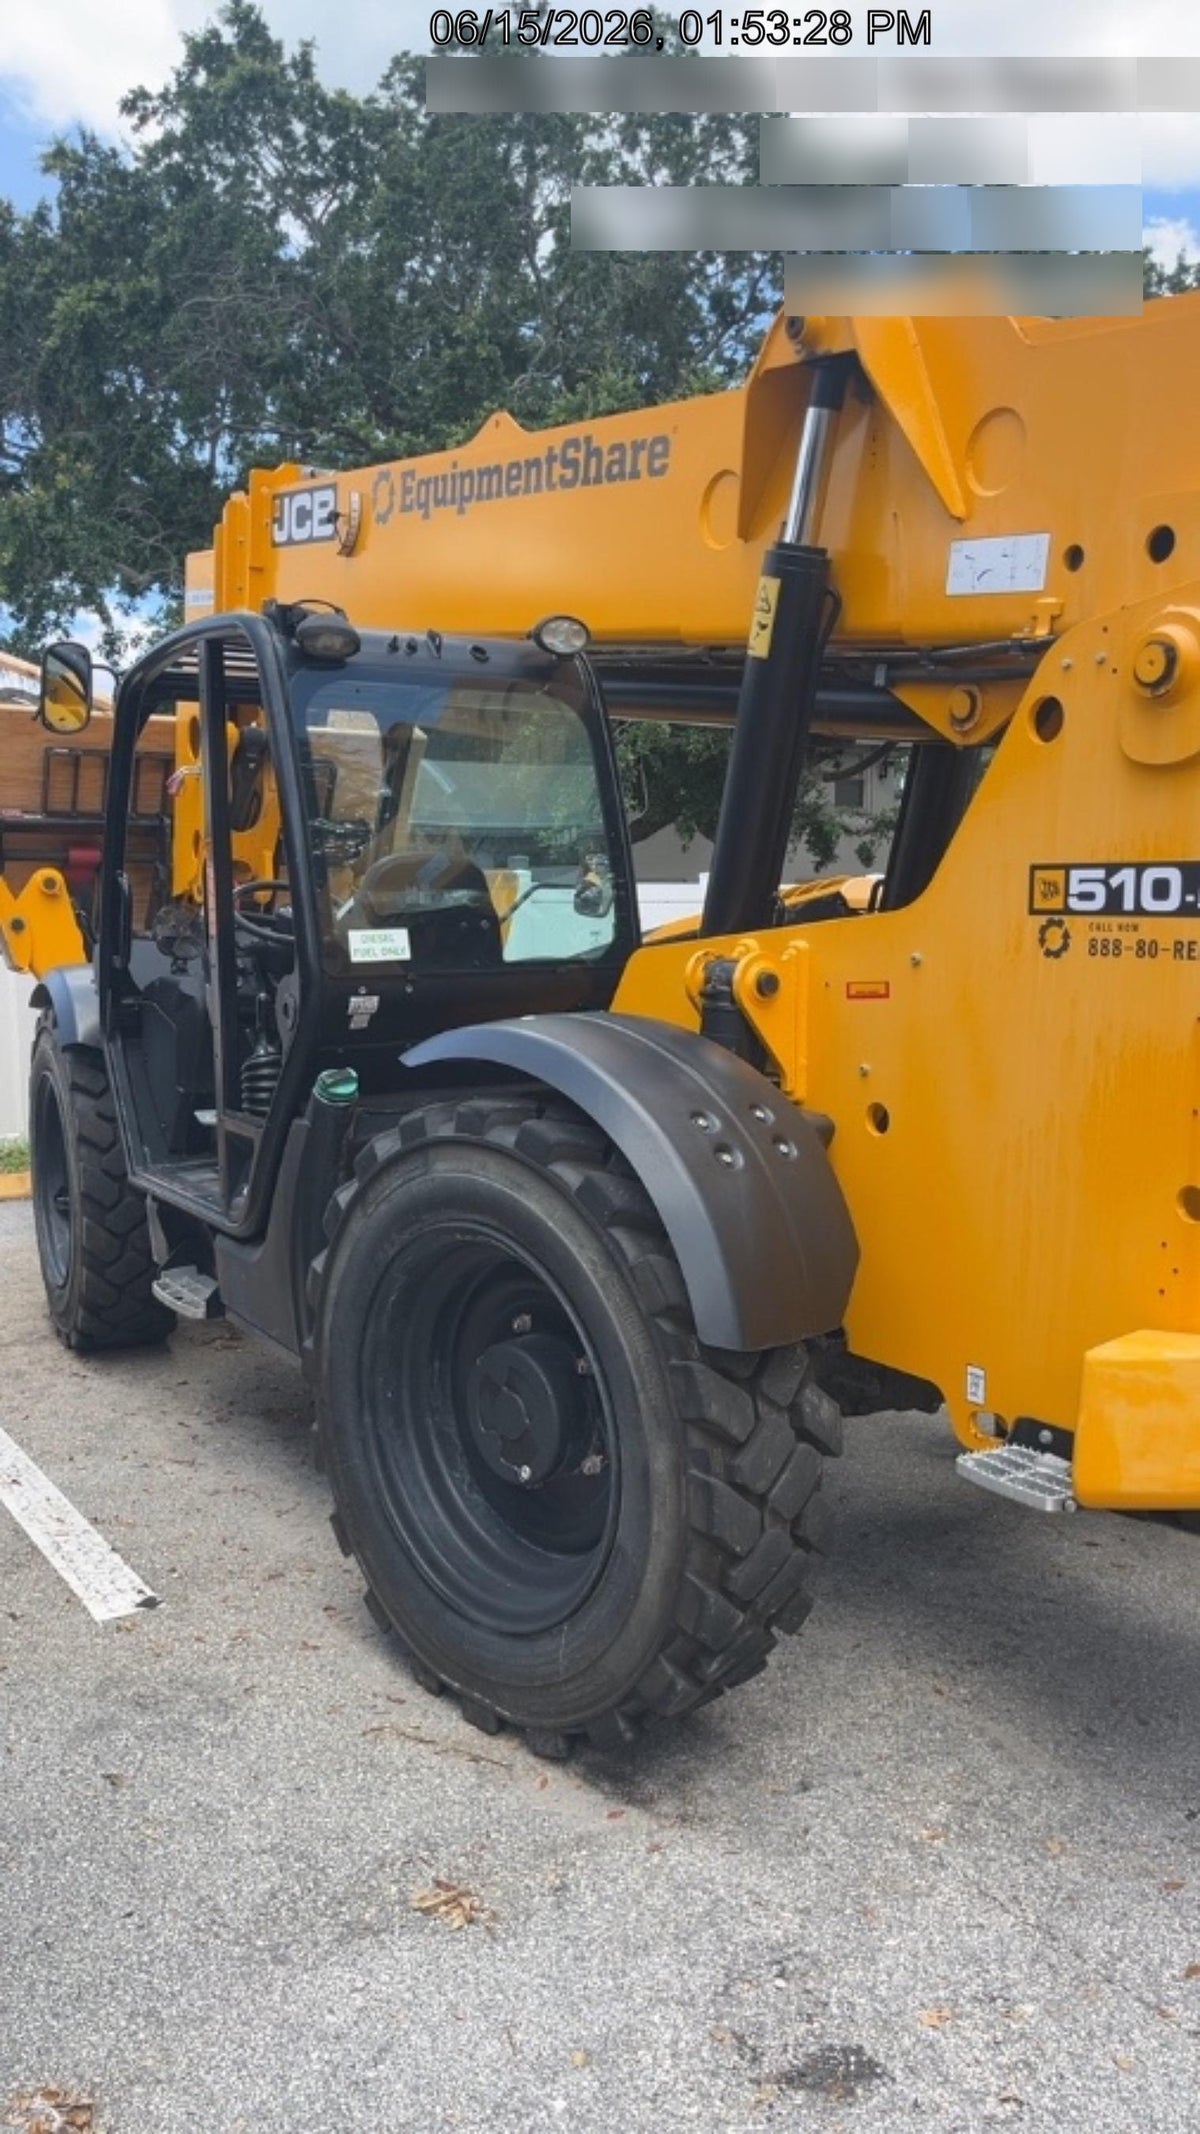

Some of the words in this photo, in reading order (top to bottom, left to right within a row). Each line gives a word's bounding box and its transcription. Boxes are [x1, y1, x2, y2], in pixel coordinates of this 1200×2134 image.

[399, 433, 671, 520] EquipmentShare
[272, 487, 336, 544] JCB
[1067, 866, 1200, 912] 510-
